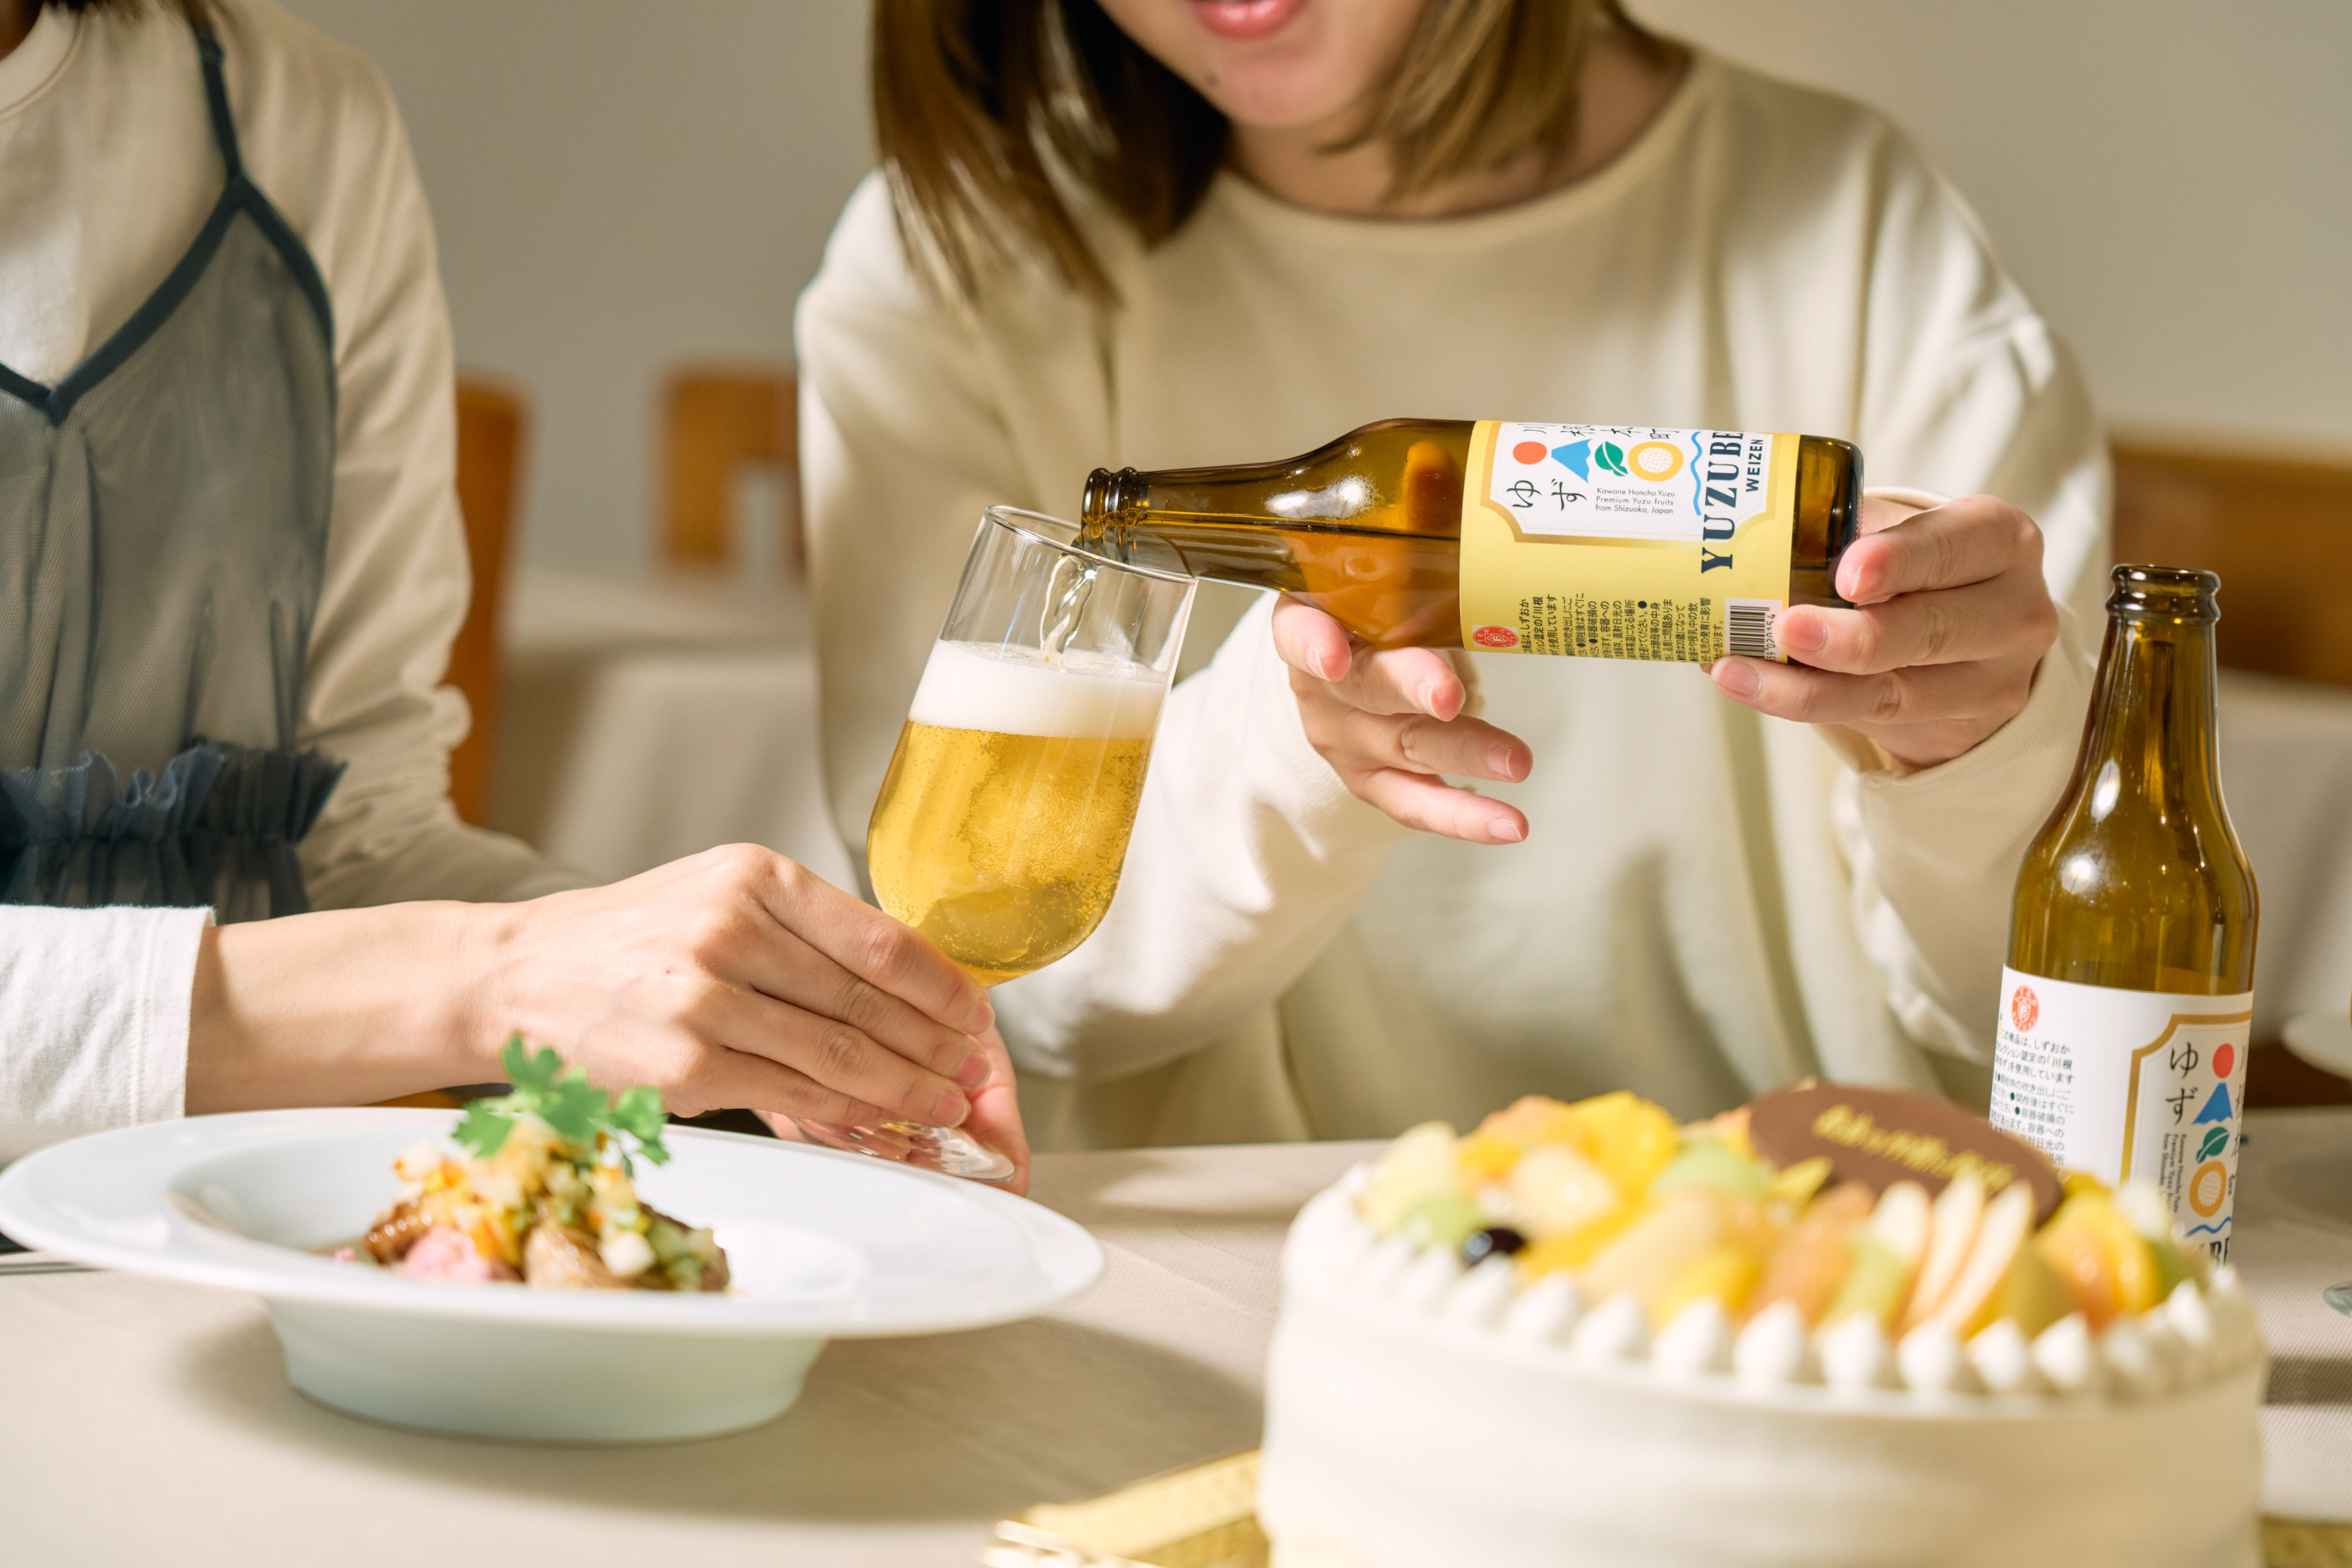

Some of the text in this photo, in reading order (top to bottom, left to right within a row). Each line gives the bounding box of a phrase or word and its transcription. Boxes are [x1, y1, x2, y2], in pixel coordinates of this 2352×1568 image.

[1745, 438, 1764, 493] WEIZEN
[1506, 478, 1588, 512] ゆず
[1651, 507, 1673, 515] Japan
[2164, 1041, 2199, 1126] ゆず
